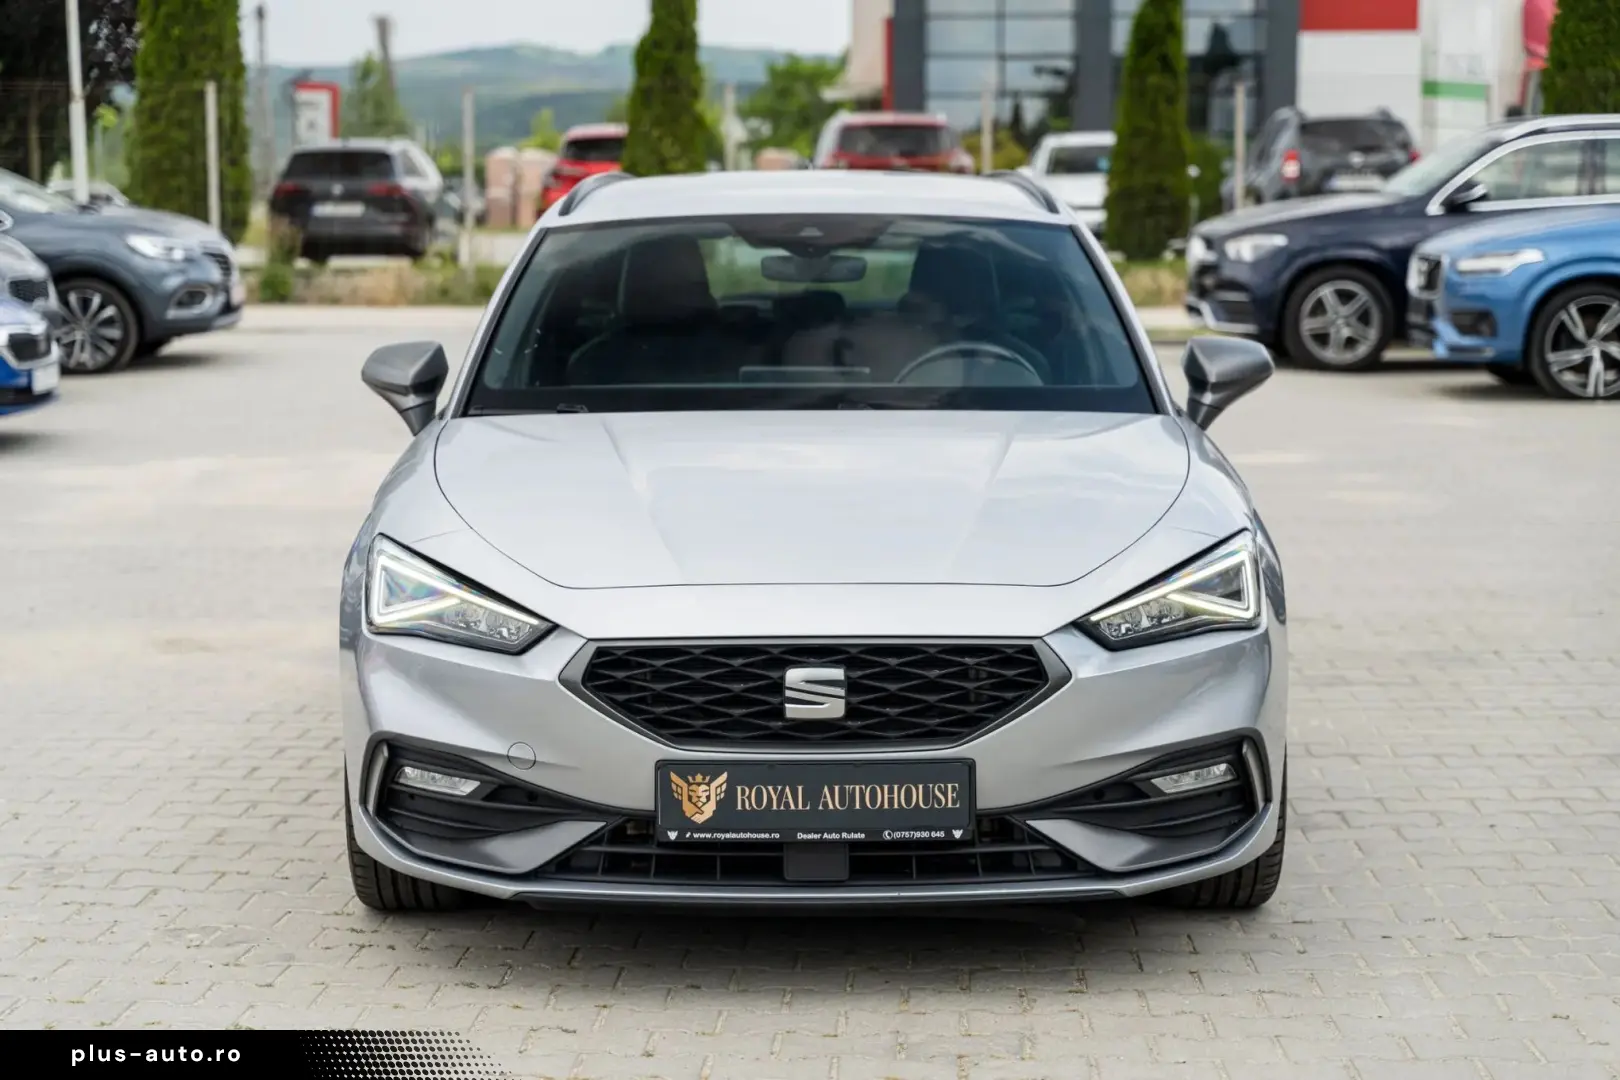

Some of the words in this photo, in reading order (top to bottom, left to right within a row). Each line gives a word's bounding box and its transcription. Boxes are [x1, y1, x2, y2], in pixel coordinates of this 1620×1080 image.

[735, 784, 811, 811] ROYAL
[818, 783, 960, 811] AUTOHOUSE
[692, 831, 780, 840] www.royalautohouse.ro
[797, 832, 822, 840] Dealer
[822, 832, 841, 840] Auto
[842, 831, 866, 840] Rulate
[930, 830, 945, 839] 645
